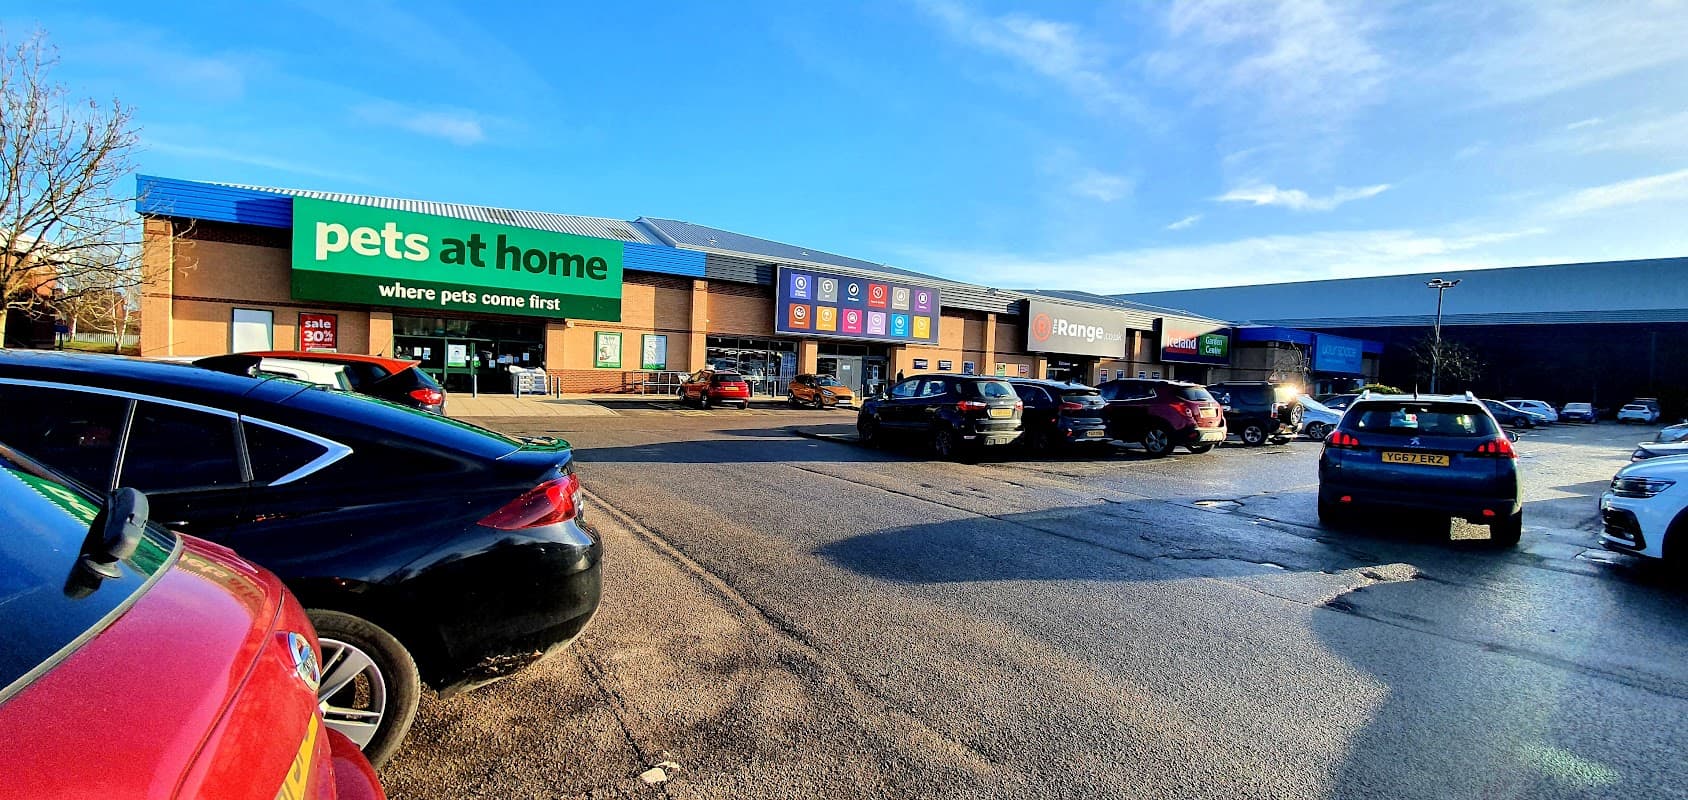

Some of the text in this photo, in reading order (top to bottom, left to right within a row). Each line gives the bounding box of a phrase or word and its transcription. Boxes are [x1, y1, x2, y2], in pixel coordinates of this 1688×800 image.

[316, 221, 608, 280] pets at home
[378, 282, 561, 310] where pets come first
[304, 319, 332, 329] sale
[1057, 319, 1104, 342] Range
[303, 329, 334, 342] 30%
[1167, 336, 1197, 350] Iceland
[1387, 452, 1444, 465] YG67 ERZ
